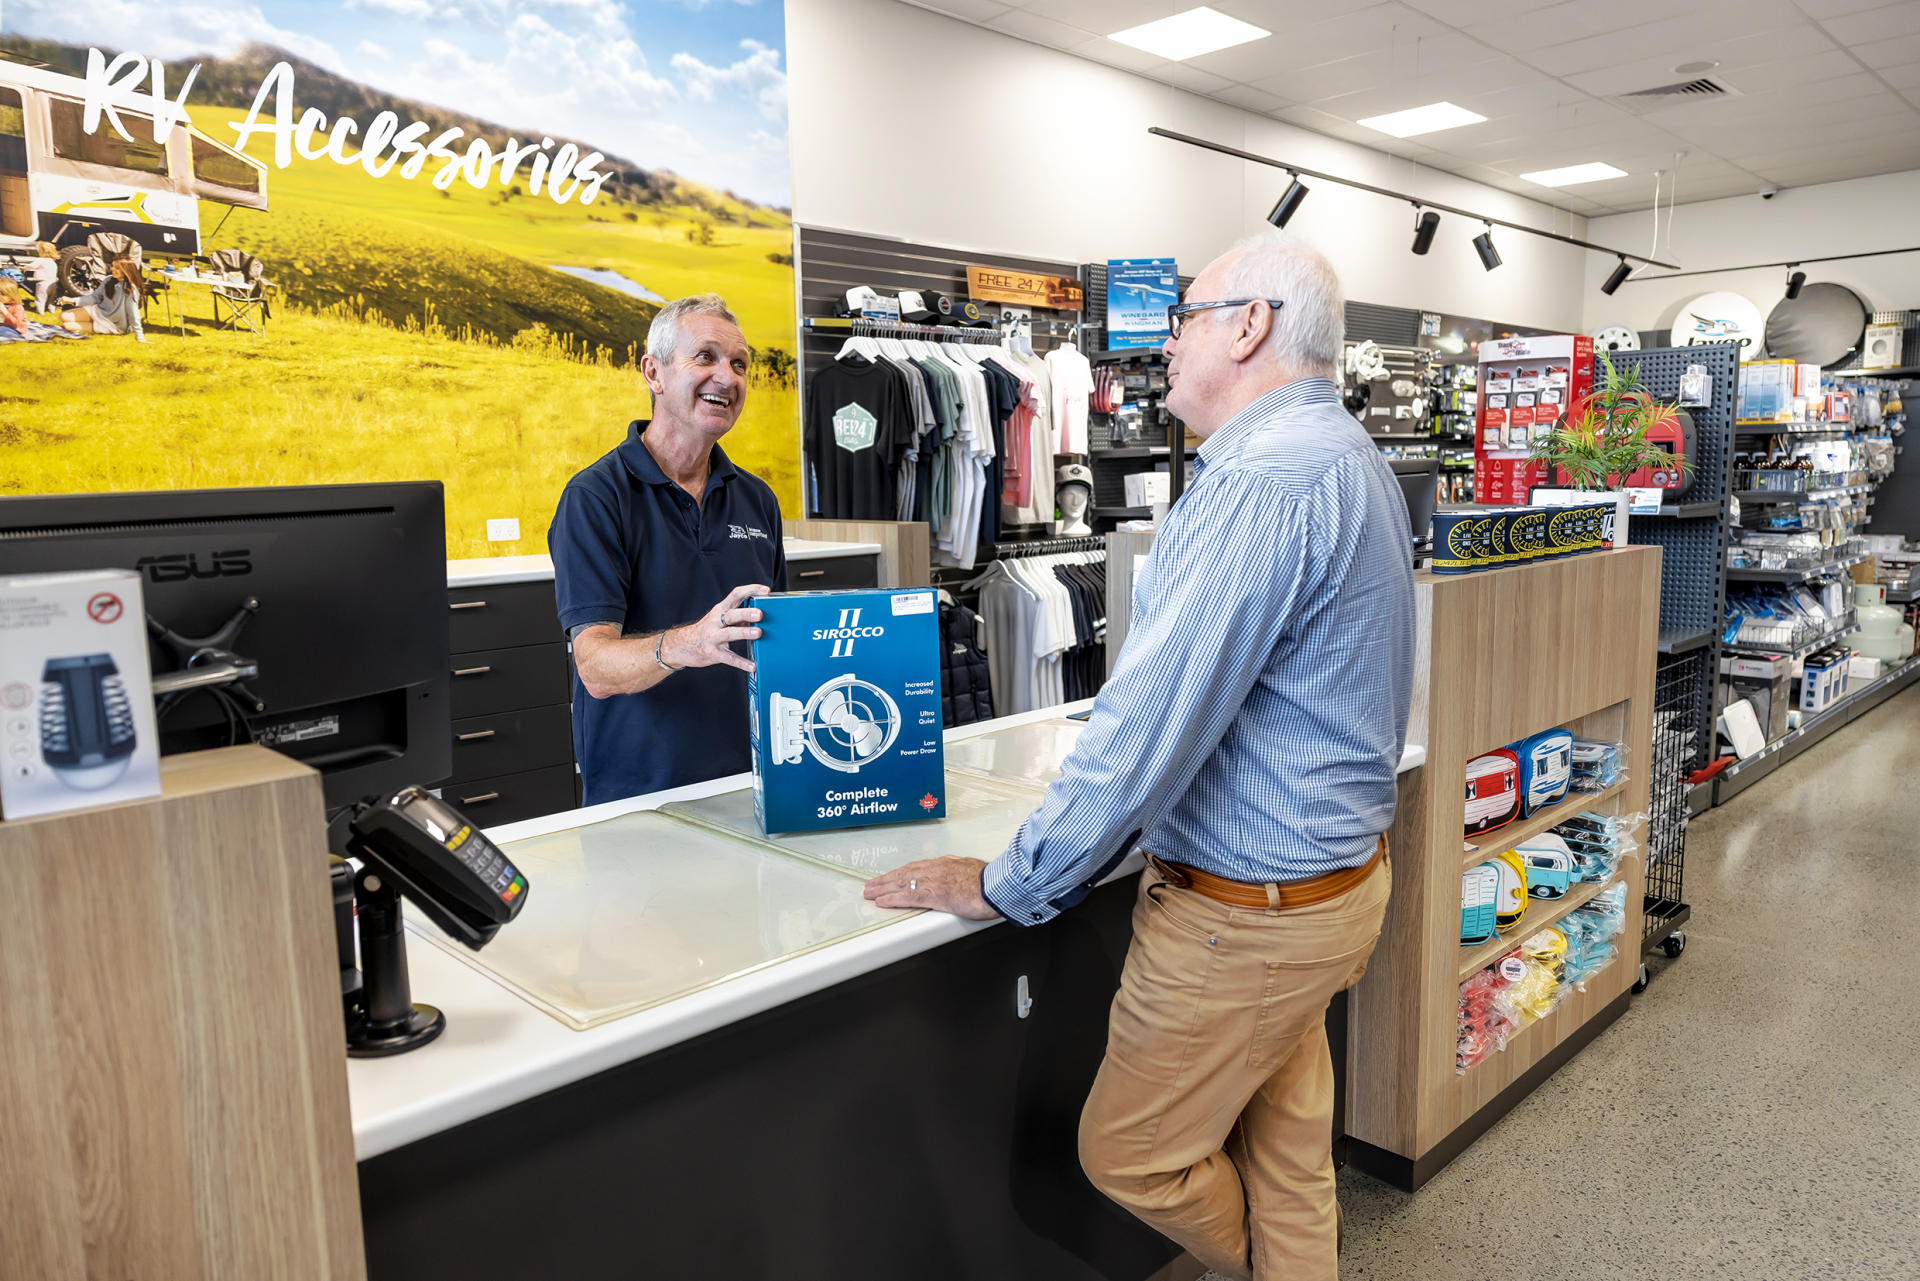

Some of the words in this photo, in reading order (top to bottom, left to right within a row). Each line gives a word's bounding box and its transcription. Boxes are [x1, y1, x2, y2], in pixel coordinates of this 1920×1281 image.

[83, 46, 203, 145] RV
[227, 61, 615, 206] Accessories
[978, 273, 1013, 288] FREE
[1018, 278, 1033, 290] 24
[729, 532, 748, 540] Jayco
[136, 549, 254, 583] ASUS
[812, 626, 885, 641] SIROCCO
[905, 680, 934, 688] Increased
[905, 688, 934, 696] Durability
[825, 786, 889, 802] Complete
[817, 804, 847, 819] 360°
[850, 801, 898, 816] Airflow
